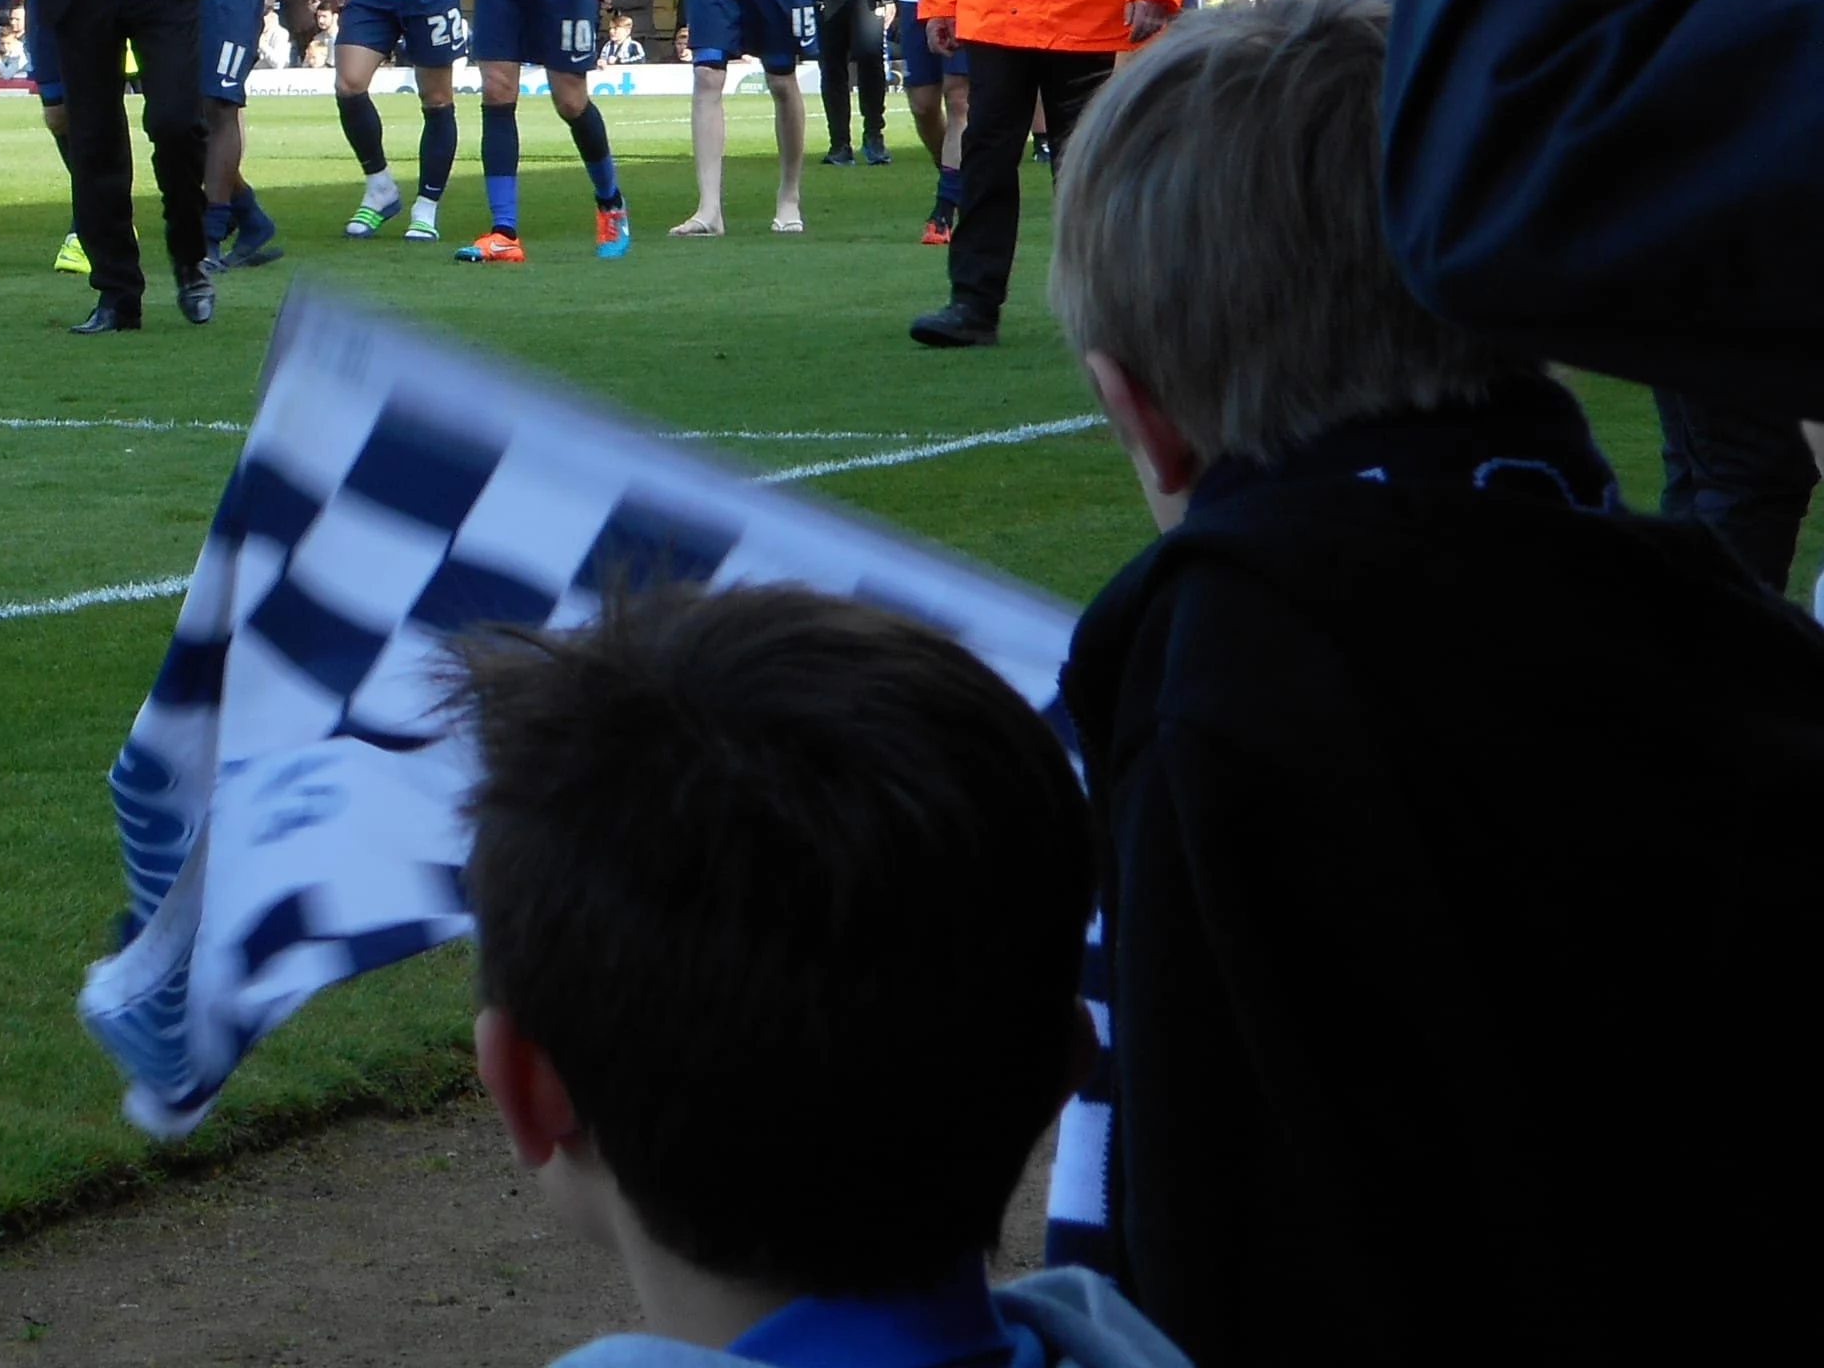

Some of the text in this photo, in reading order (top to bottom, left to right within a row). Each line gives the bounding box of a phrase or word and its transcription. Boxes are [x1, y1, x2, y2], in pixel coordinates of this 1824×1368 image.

[427, 7, 464, 47] 22
[561, 19, 592, 52] 10
[791, 6, 816, 37] 15
[216, 40, 247, 80] 11
